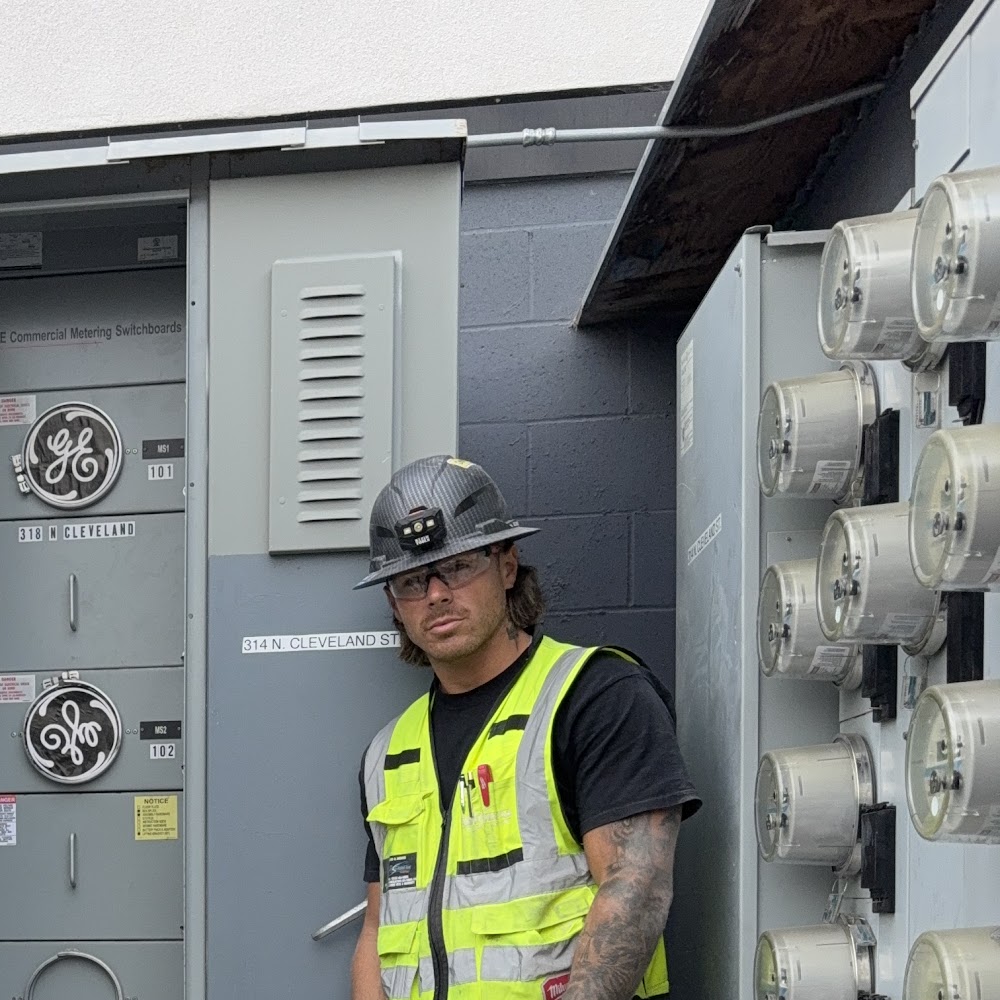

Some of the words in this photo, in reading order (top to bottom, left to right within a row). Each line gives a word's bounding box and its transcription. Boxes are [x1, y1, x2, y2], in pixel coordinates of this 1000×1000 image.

[9, 328, 67, 343] Commercial
[70, 327, 112, 340] Metering
[115, 321, 182, 337] Switchboards
[157, 444, 170, 453] MS1
[151, 465, 172, 478] 101
[20, 527, 41, 541] 318
[50, 527, 56, 539] N
[64, 523, 134, 539] CLEVELAND
[244, 639, 267, 651] 314
[272, 638, 285, 650] N.
[290, 634, 376, 650] CLEVELAND
[154, 726, 167, 735] MS2
[152, 744, 174, 757] 102
